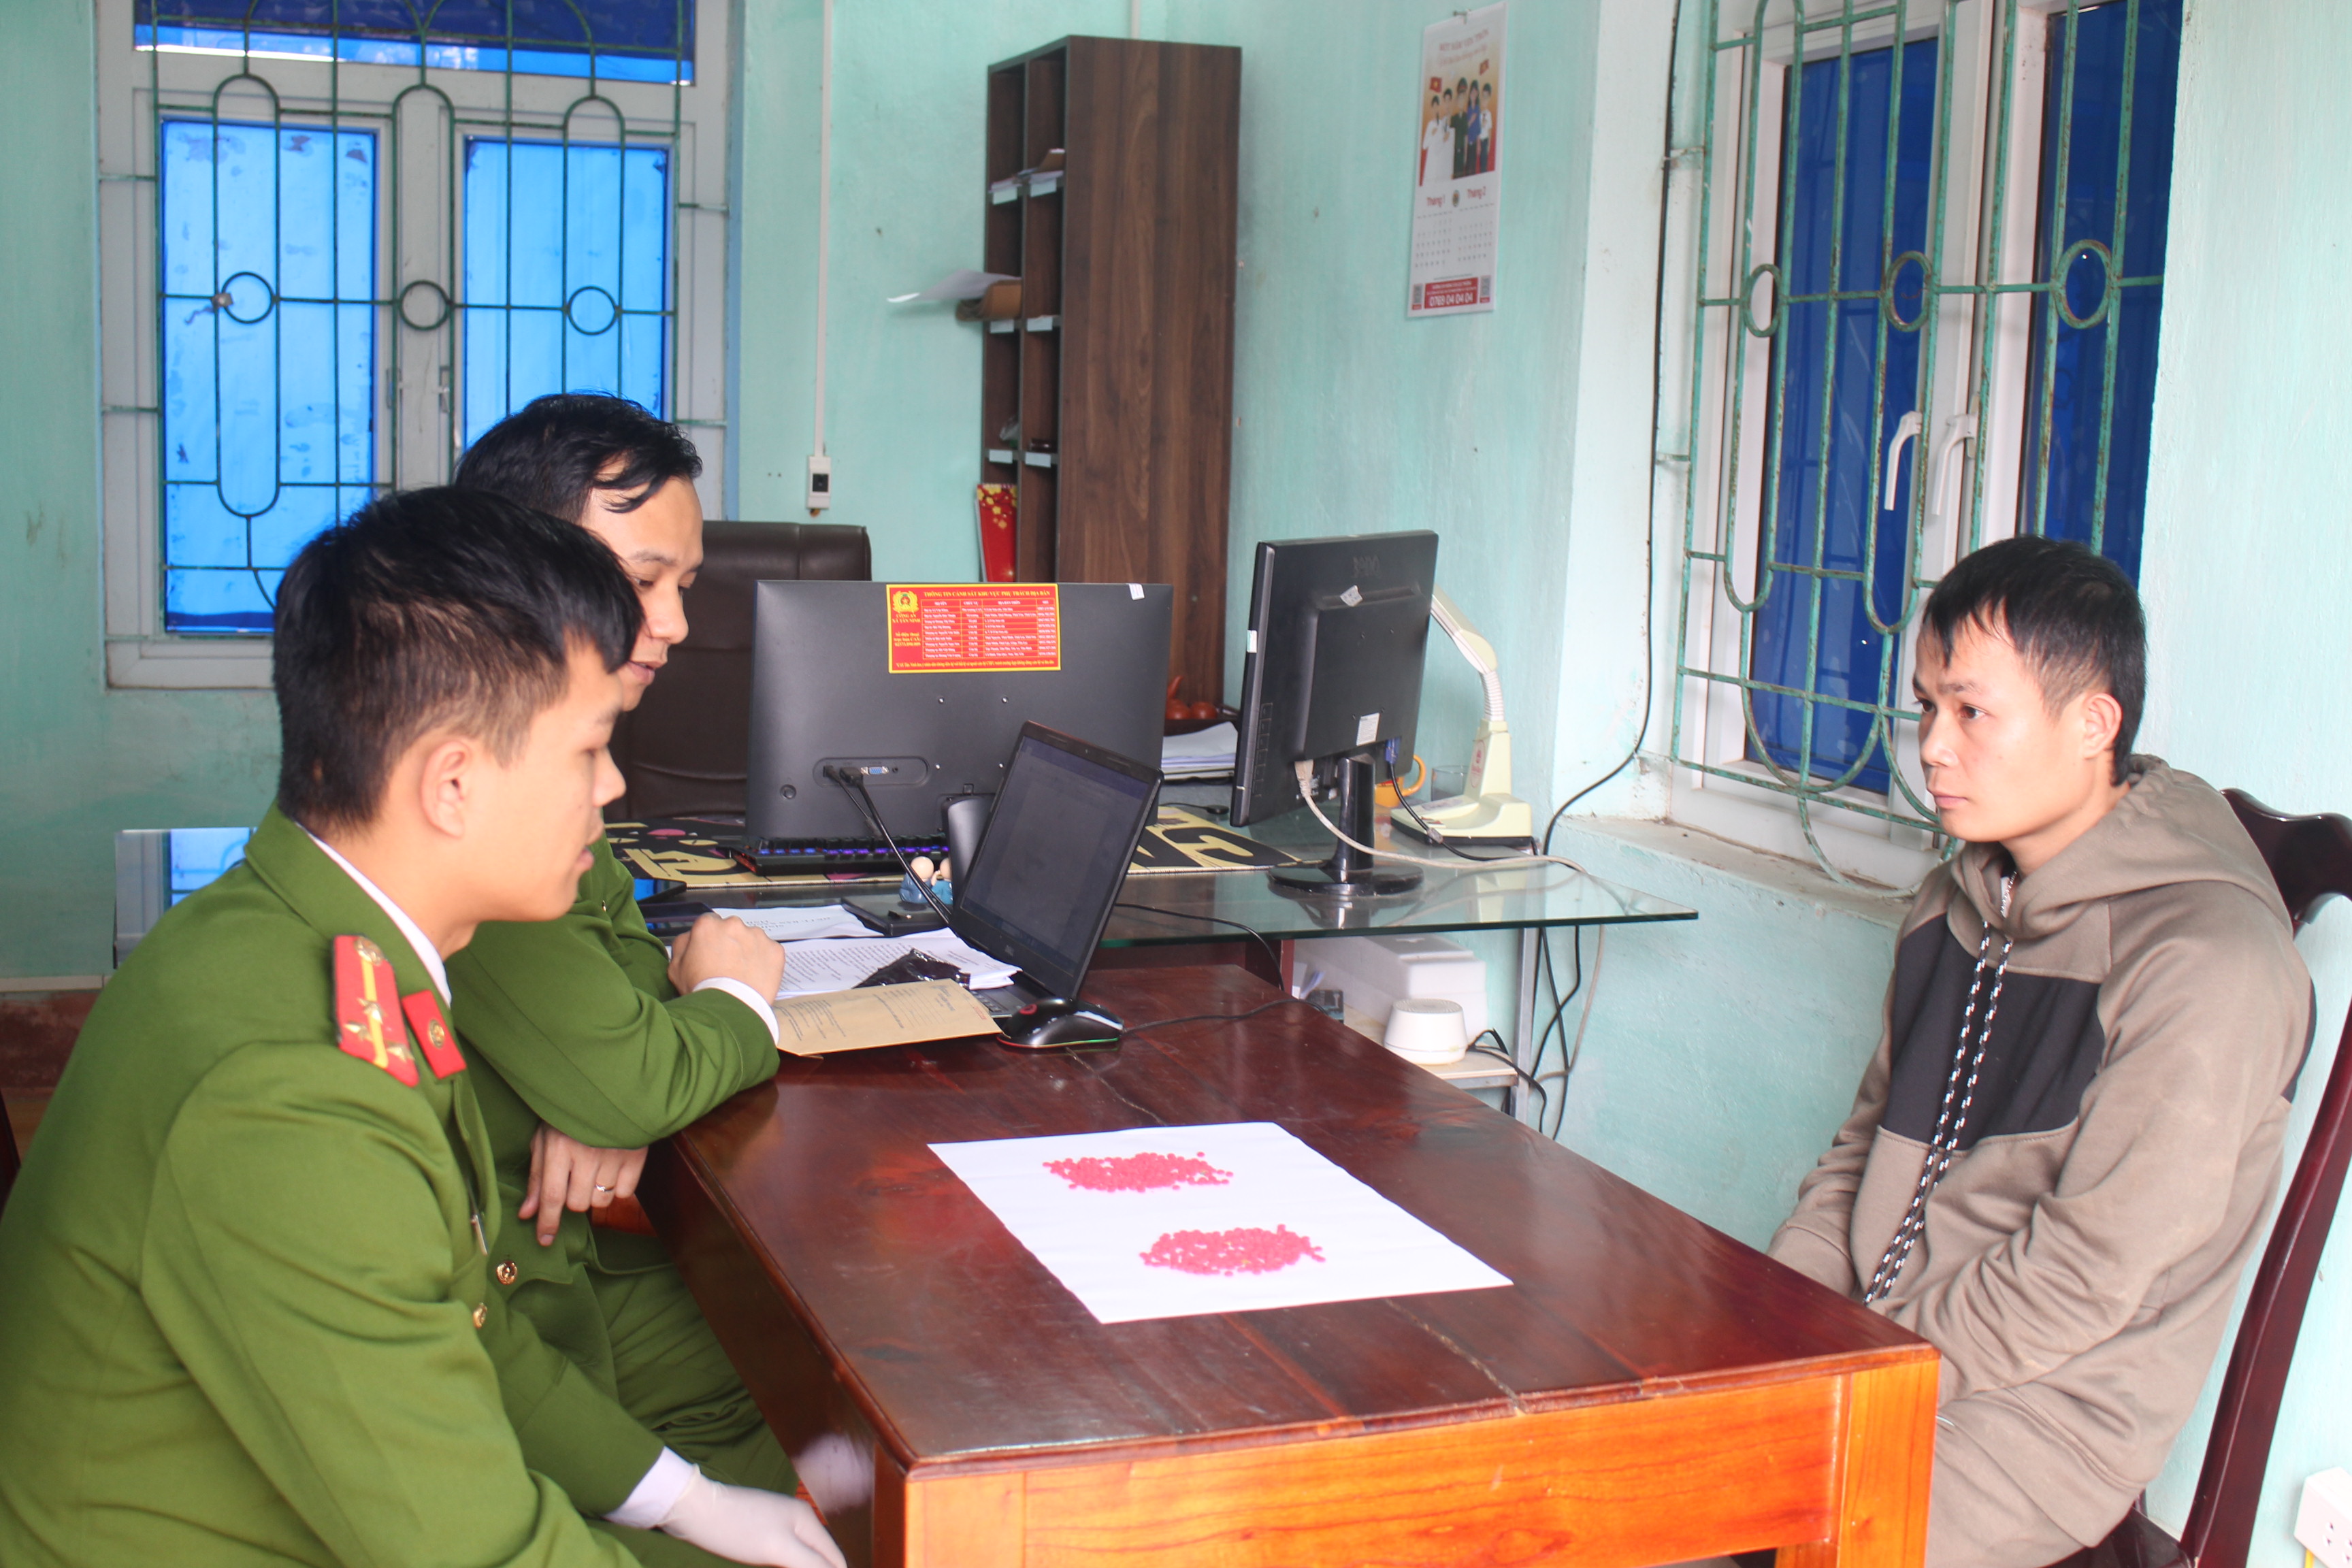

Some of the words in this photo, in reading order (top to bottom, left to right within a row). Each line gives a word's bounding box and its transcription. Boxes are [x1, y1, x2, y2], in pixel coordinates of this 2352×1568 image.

[1467, 189, 1482, 200] Tháng
[1426, 197, 1443, 208] Tháng
[1446, 293, 1455, 306] 04
[1455, 293, 1464, 304] 04
[1465, 292, 1473, 304] 04
